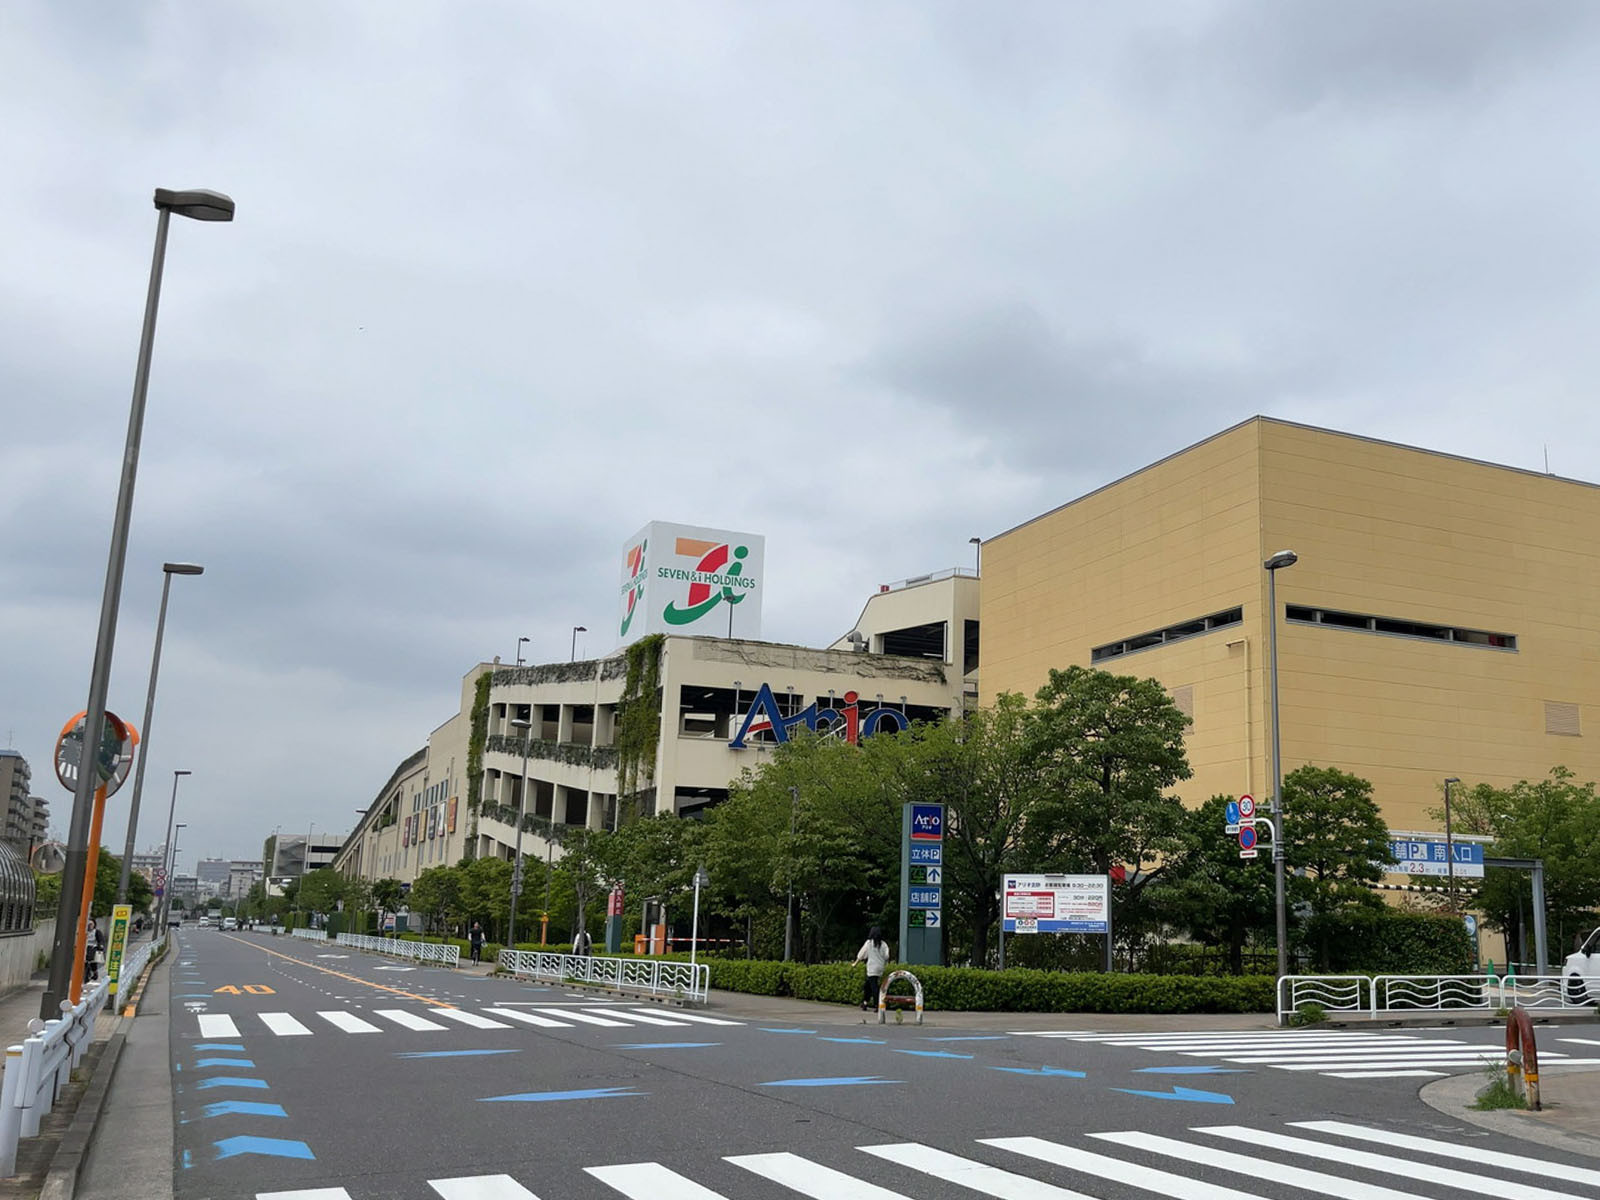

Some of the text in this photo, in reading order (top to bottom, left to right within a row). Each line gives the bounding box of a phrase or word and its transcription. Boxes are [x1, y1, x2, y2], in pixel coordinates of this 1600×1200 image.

[703, 573, 756, 589] HOLDINGS
[728, 682, 910, 750] Ario
[1242, 800, 1251, 811] 30
[914, 814, 940, 825] Ario
[213, 984, 277, 996] 40
